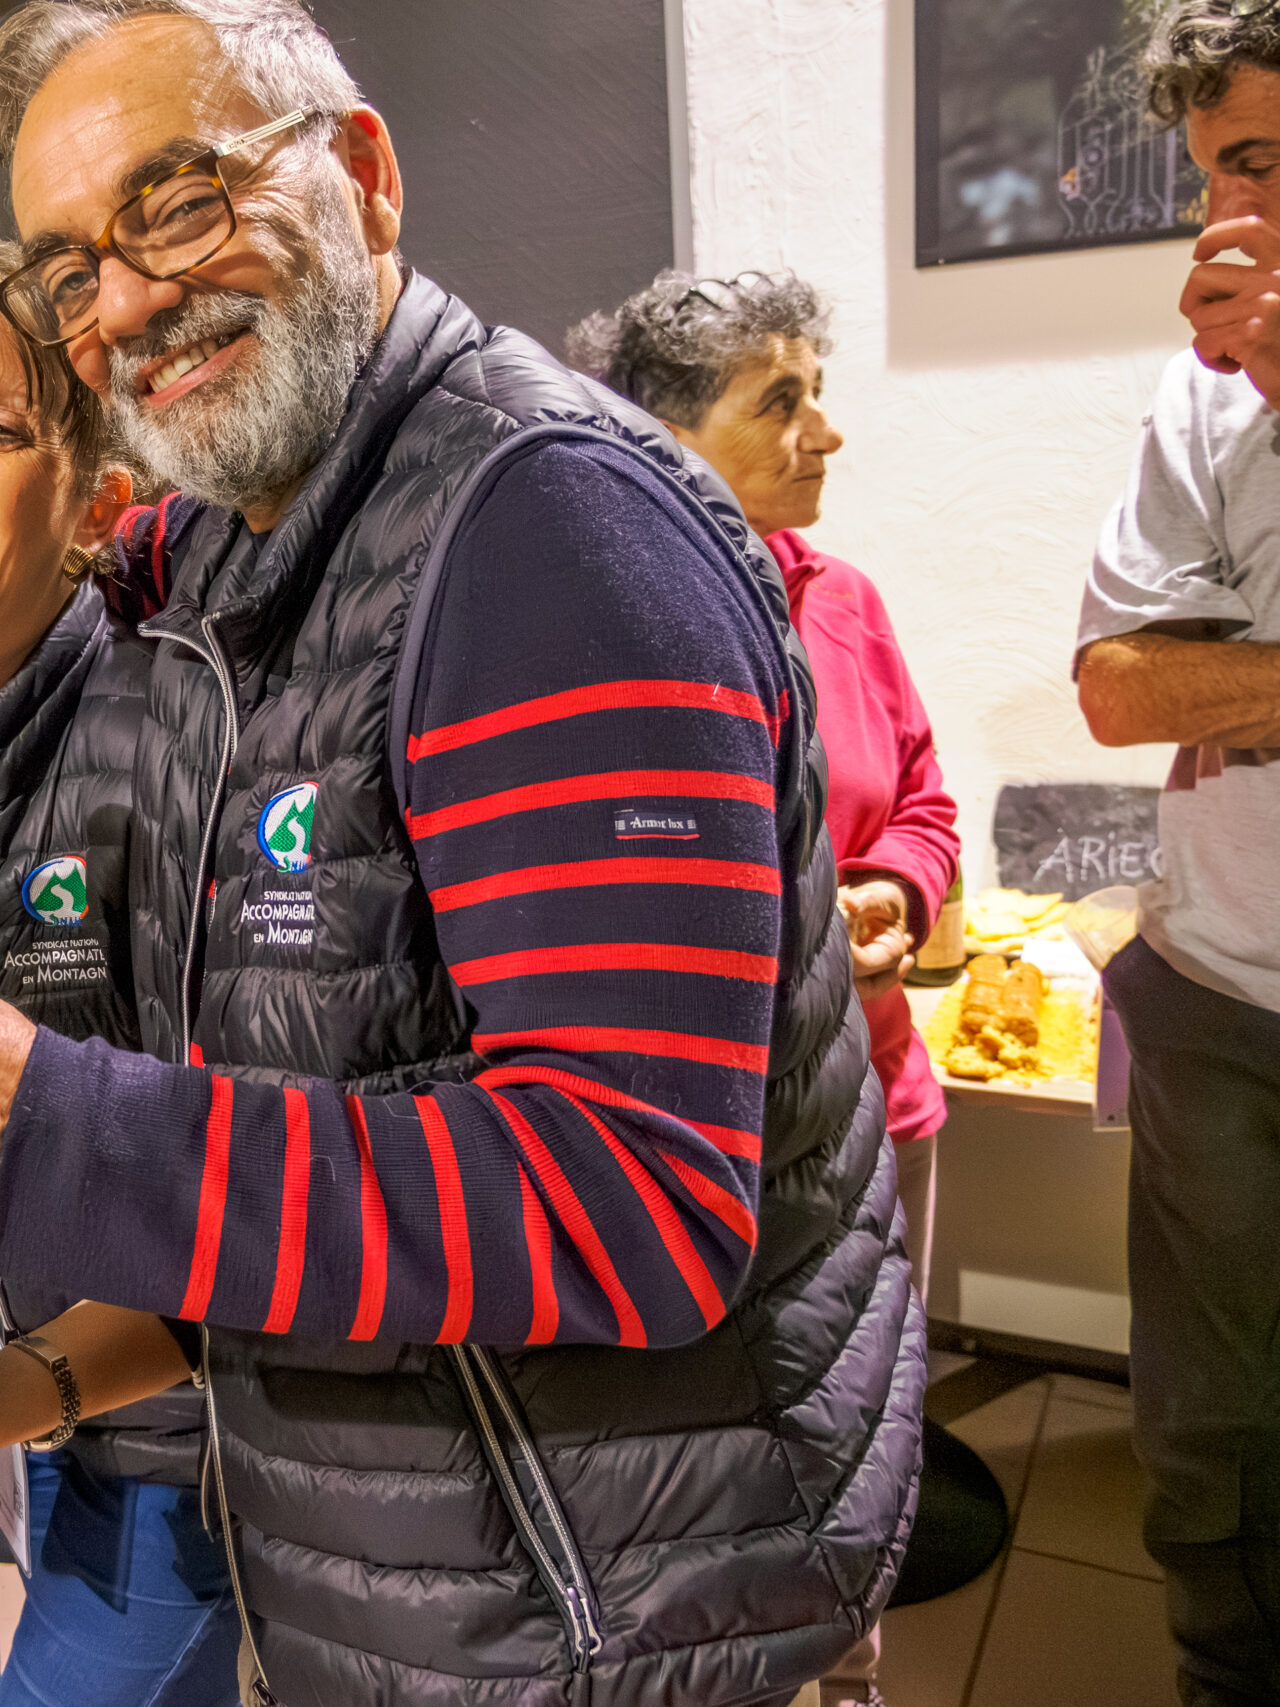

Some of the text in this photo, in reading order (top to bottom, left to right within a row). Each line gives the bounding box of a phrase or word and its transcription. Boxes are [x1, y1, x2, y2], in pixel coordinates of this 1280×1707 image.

[629, 815, 684, 829] Armor lux
[263, 890, 294, 901] SYNDICAT
[32, 937, 99, 950] SYNDICAT NATION
[253, 933, 265, 943] EN
[22, 976, 34, 984] EN
